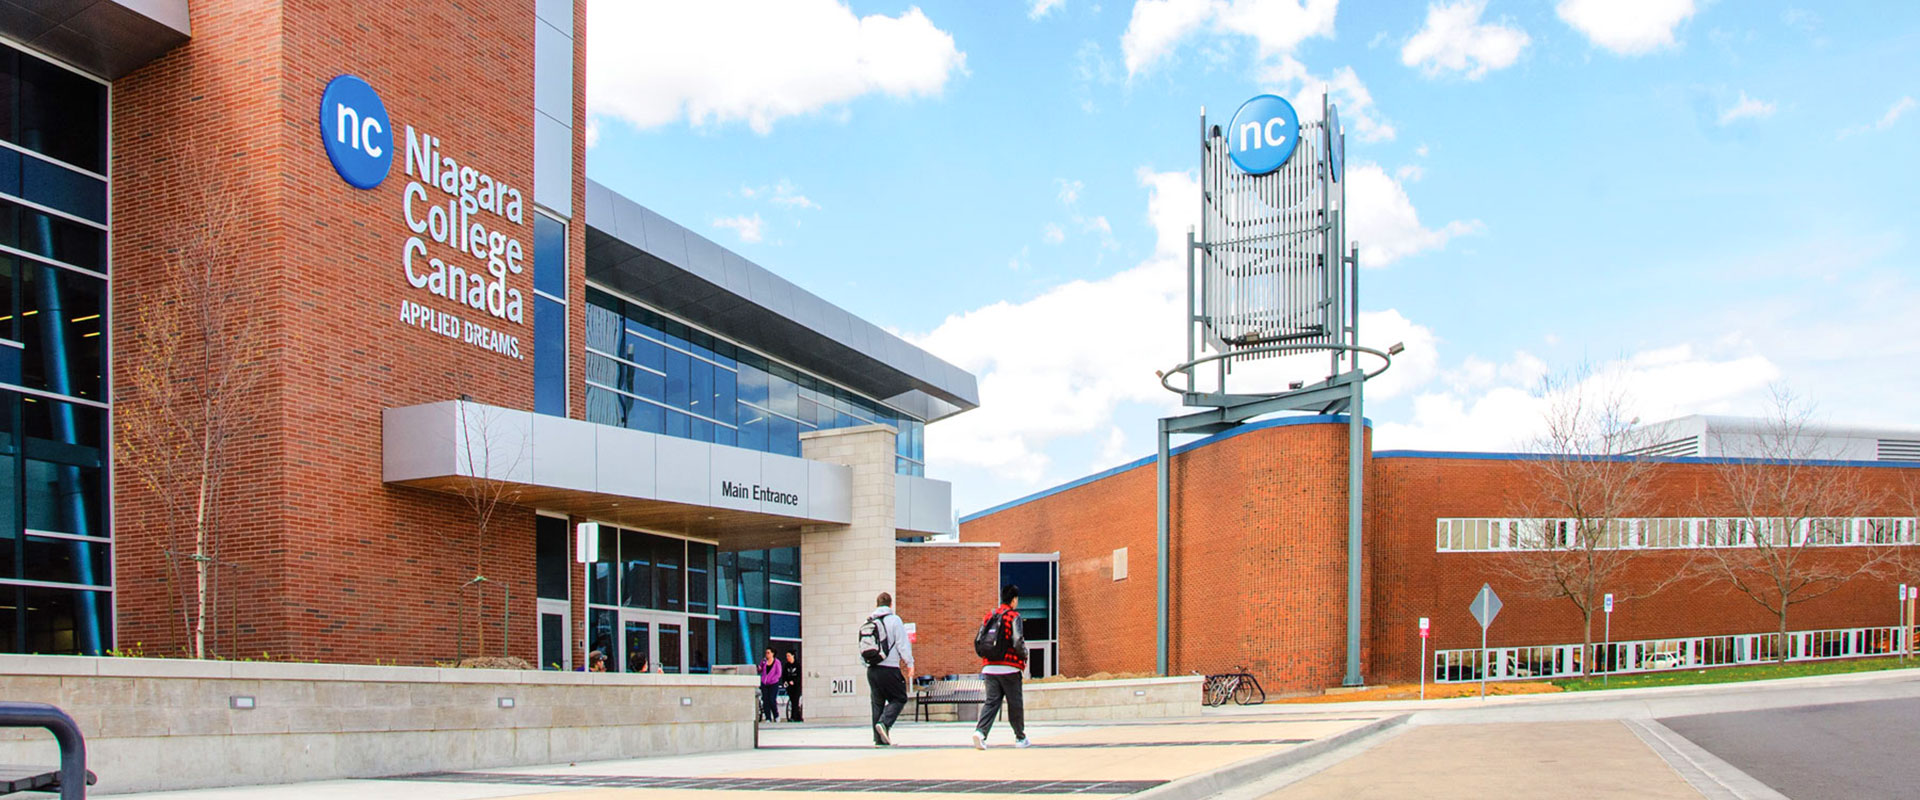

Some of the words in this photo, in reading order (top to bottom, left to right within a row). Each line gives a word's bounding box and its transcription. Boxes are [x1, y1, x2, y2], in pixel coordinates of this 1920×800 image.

[337, 102, 383, 158] nc
[1240, 117, 1286, 152] nc
[405, 124, 523, 225] Niagara
[403, 181, 523, 278] College
[402, 236, 523, 324] Canada
[400, 300, 460, 339] APPLIED
[464, 321, 524, 360] DREAMS.
[722, 480, 749, 499] Main
[752, 484, 798, 506] Entrance
[832, 680, 853, 694] 2011
